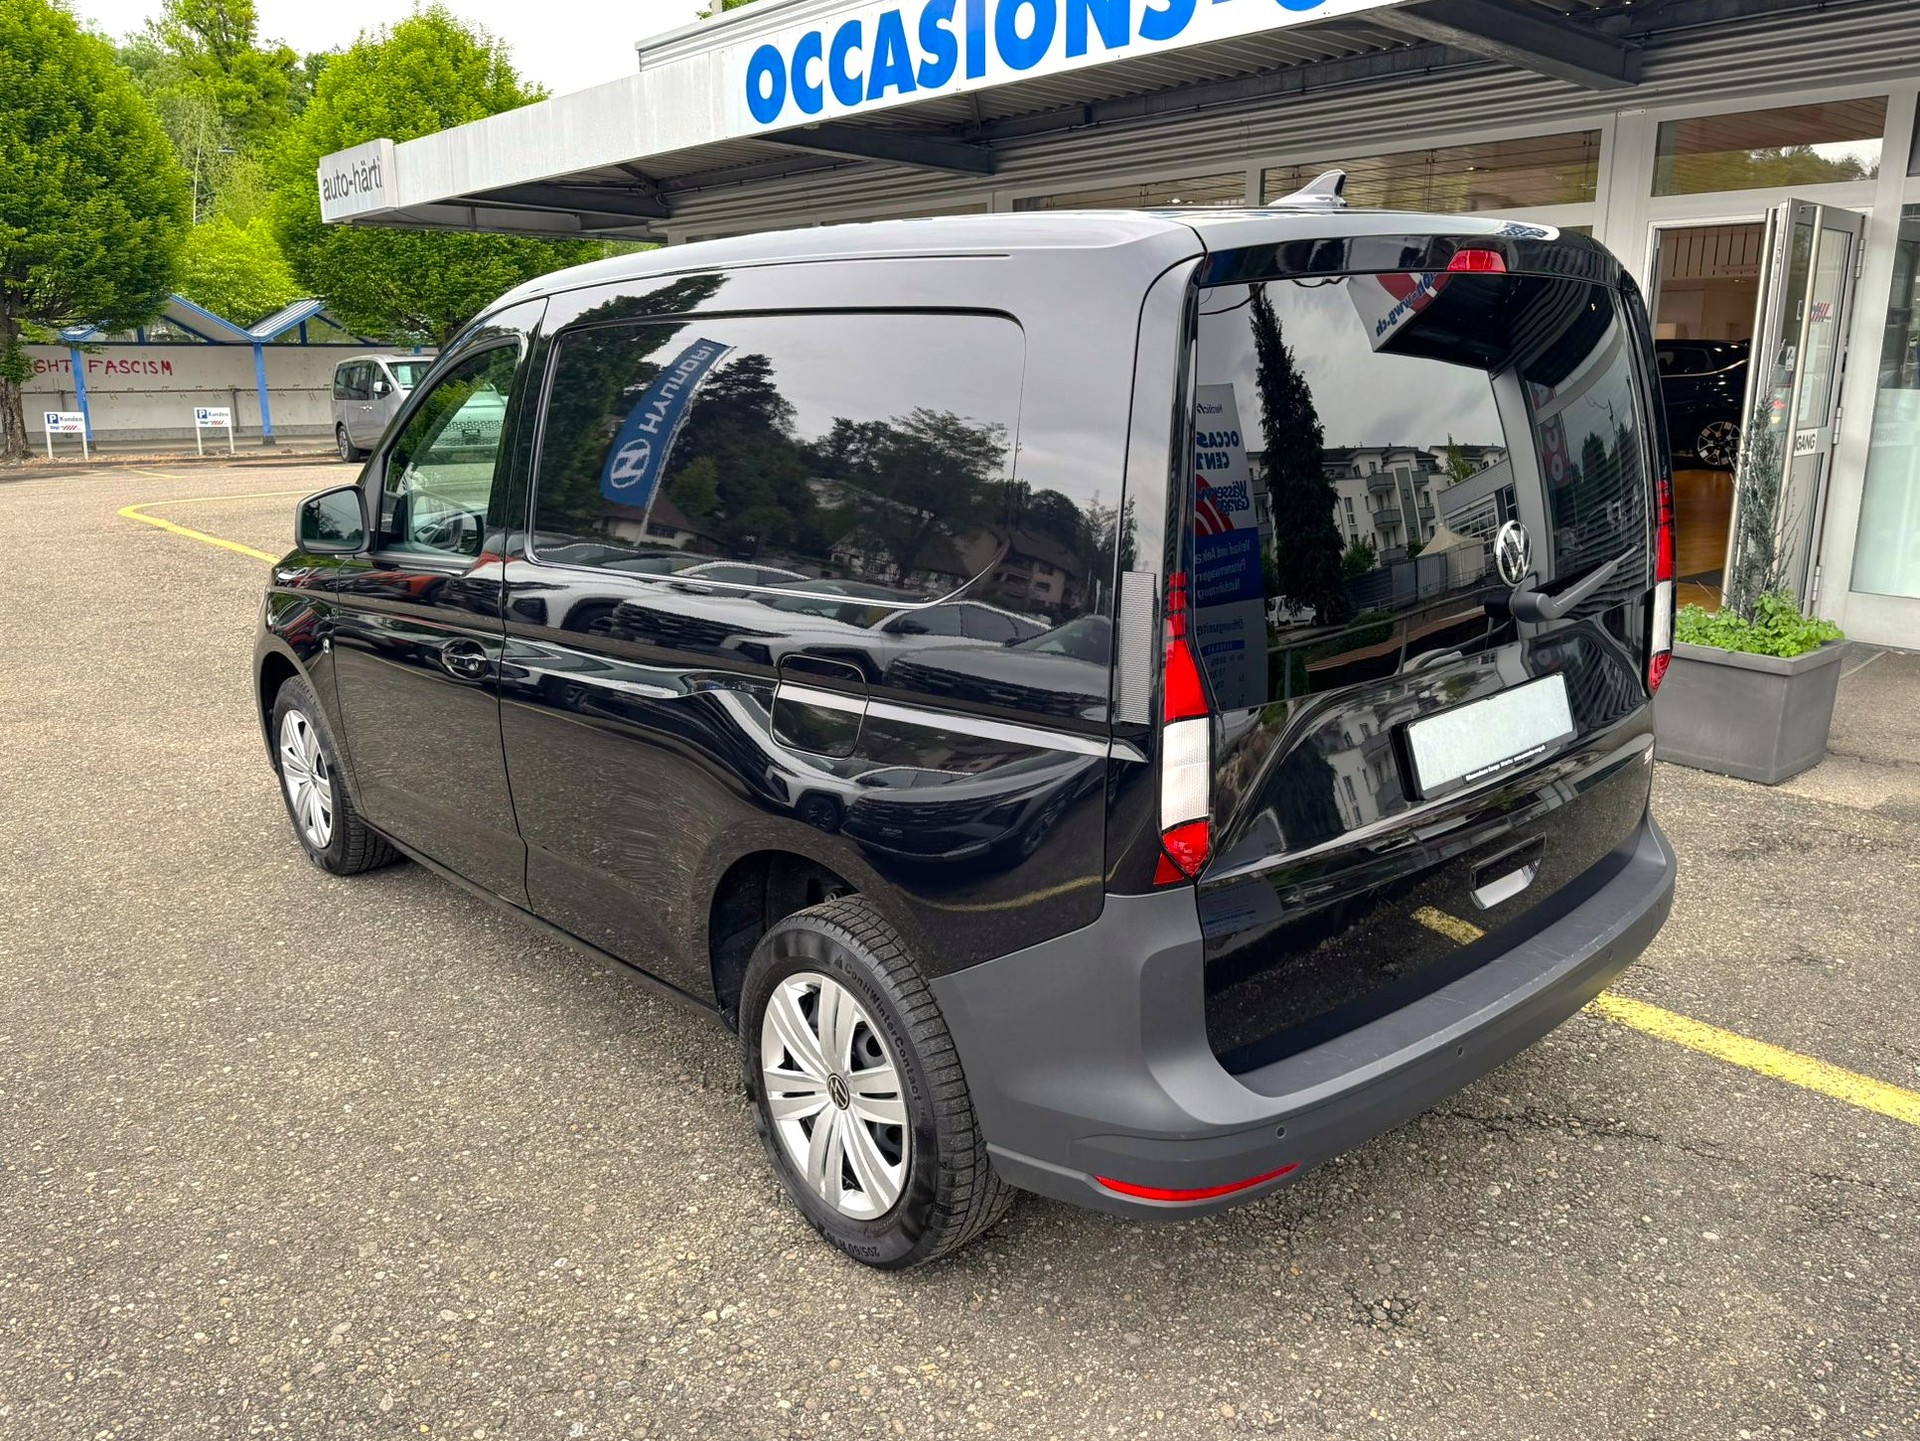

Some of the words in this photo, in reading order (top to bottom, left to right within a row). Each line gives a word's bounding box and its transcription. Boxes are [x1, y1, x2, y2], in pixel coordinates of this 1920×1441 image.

[746, 0, 1330, 125] OCCASION
[34, 359, 72, 374] GHT
[88, 359, 173, 376] FASCISM
[1796, 433, 1816, 451] GANG
